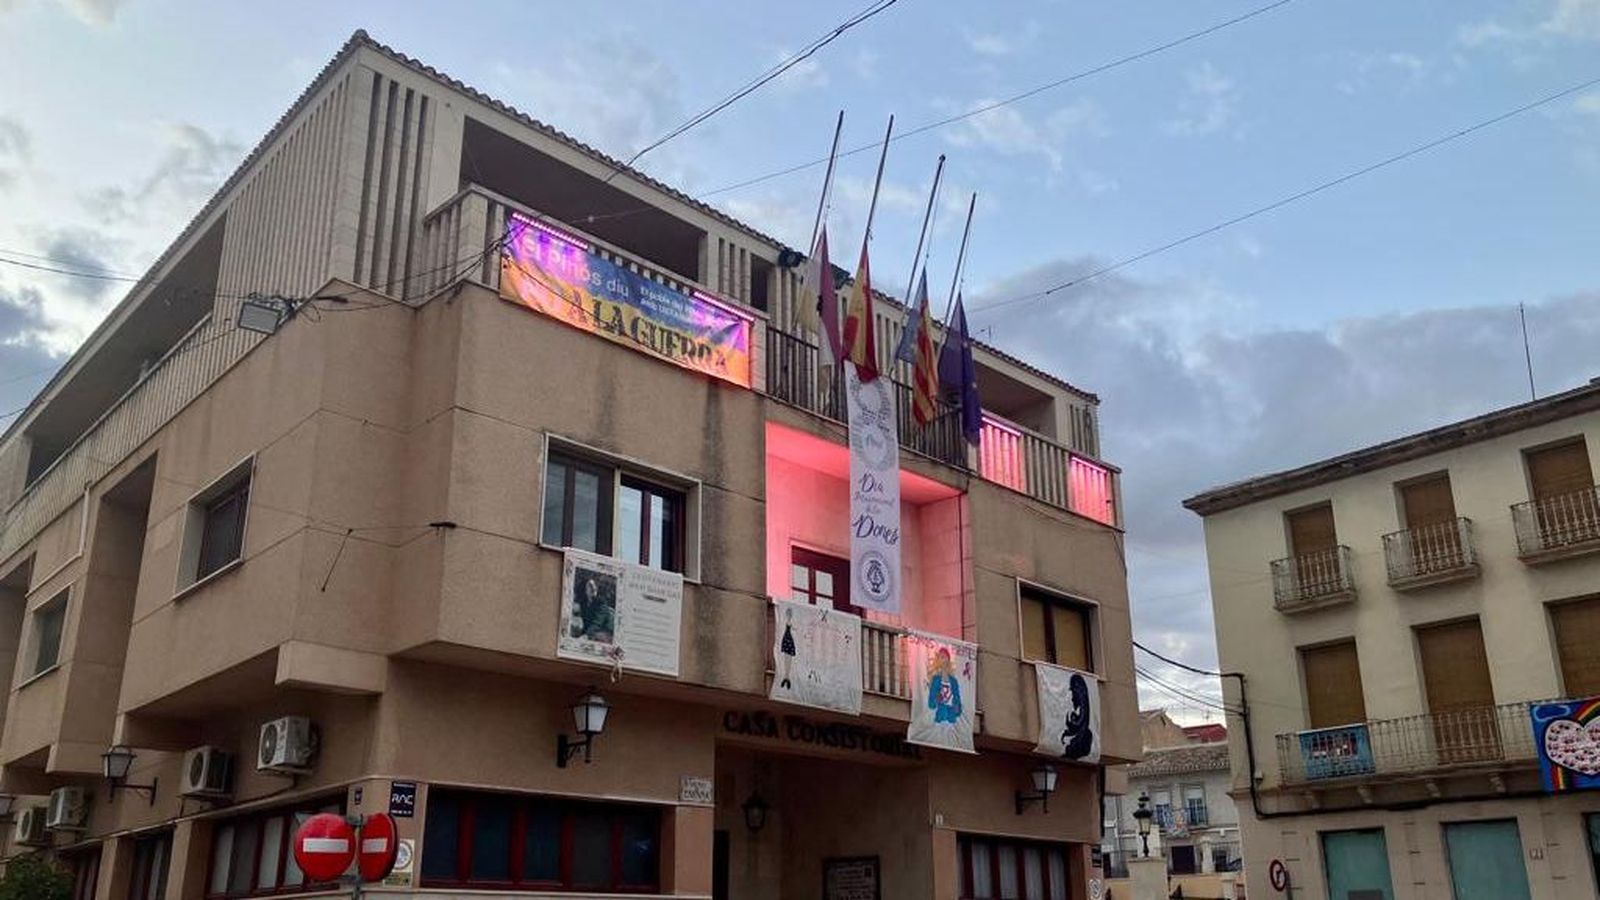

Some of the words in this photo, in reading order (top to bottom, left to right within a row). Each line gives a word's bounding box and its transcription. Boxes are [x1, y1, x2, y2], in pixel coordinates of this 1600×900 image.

[607, 278, 629, 298] diu
[591, 298, 626, 337] LA
[724, 711, 779, 737] CASA
